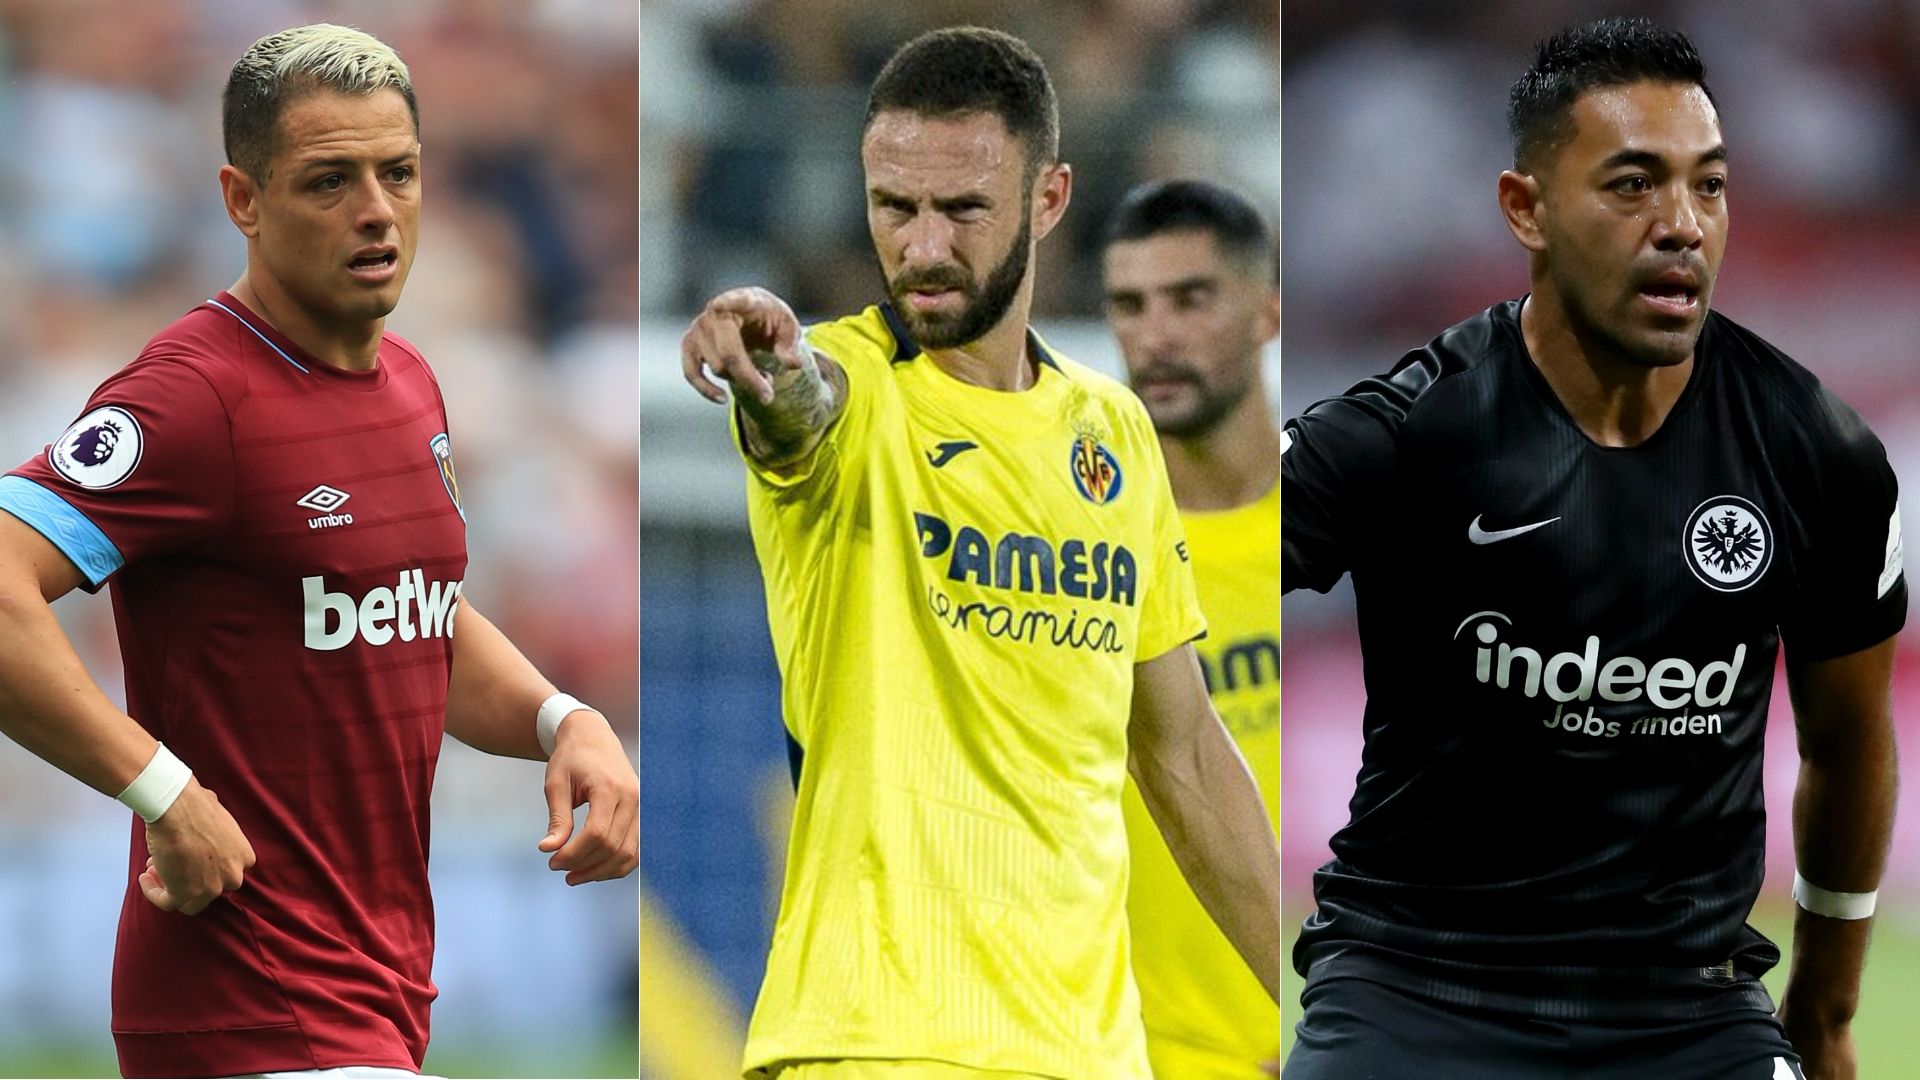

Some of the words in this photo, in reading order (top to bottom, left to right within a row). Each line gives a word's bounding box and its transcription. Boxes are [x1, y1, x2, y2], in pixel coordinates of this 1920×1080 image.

[308, 513, 353, 530] umbro
[913, 511, 1136, 608] PAMESA
[1475, 622, 1747, 710] indeed
[1543, 704, 1621, 738] Jobs
